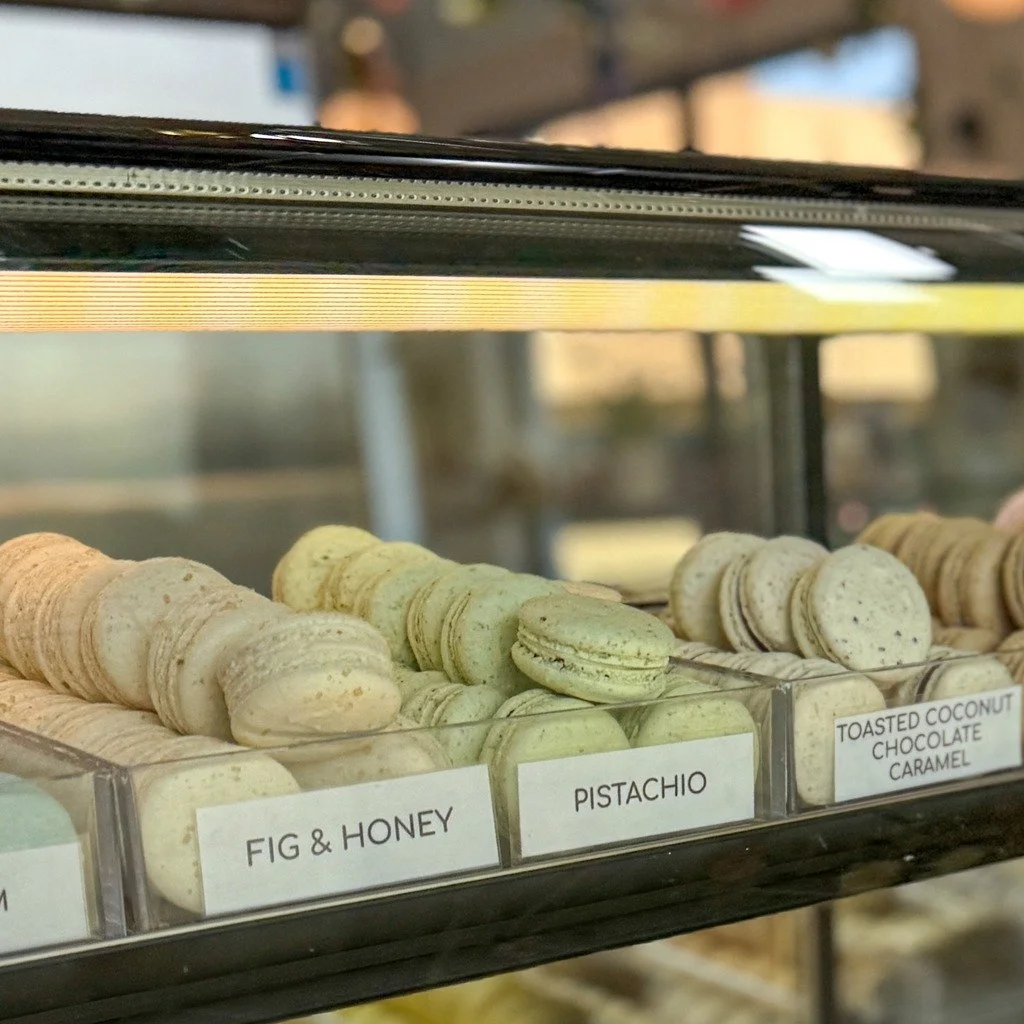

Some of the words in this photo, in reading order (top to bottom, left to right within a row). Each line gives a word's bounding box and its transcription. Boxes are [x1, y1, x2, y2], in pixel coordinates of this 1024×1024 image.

[837, 711, 920, 743] TOASTED
[925, 693, 1014, 732] COCONUT
[872, 723, 983, 761] CHOCOLATE
[888, 750, 971, 782] CARAMEL
[573, 769, 708, 813] PISTACHIO
[246, 831, 301, 868] FIG
[310, 828, 333, 857] &
[341, 806, 455, 851] HONEY
